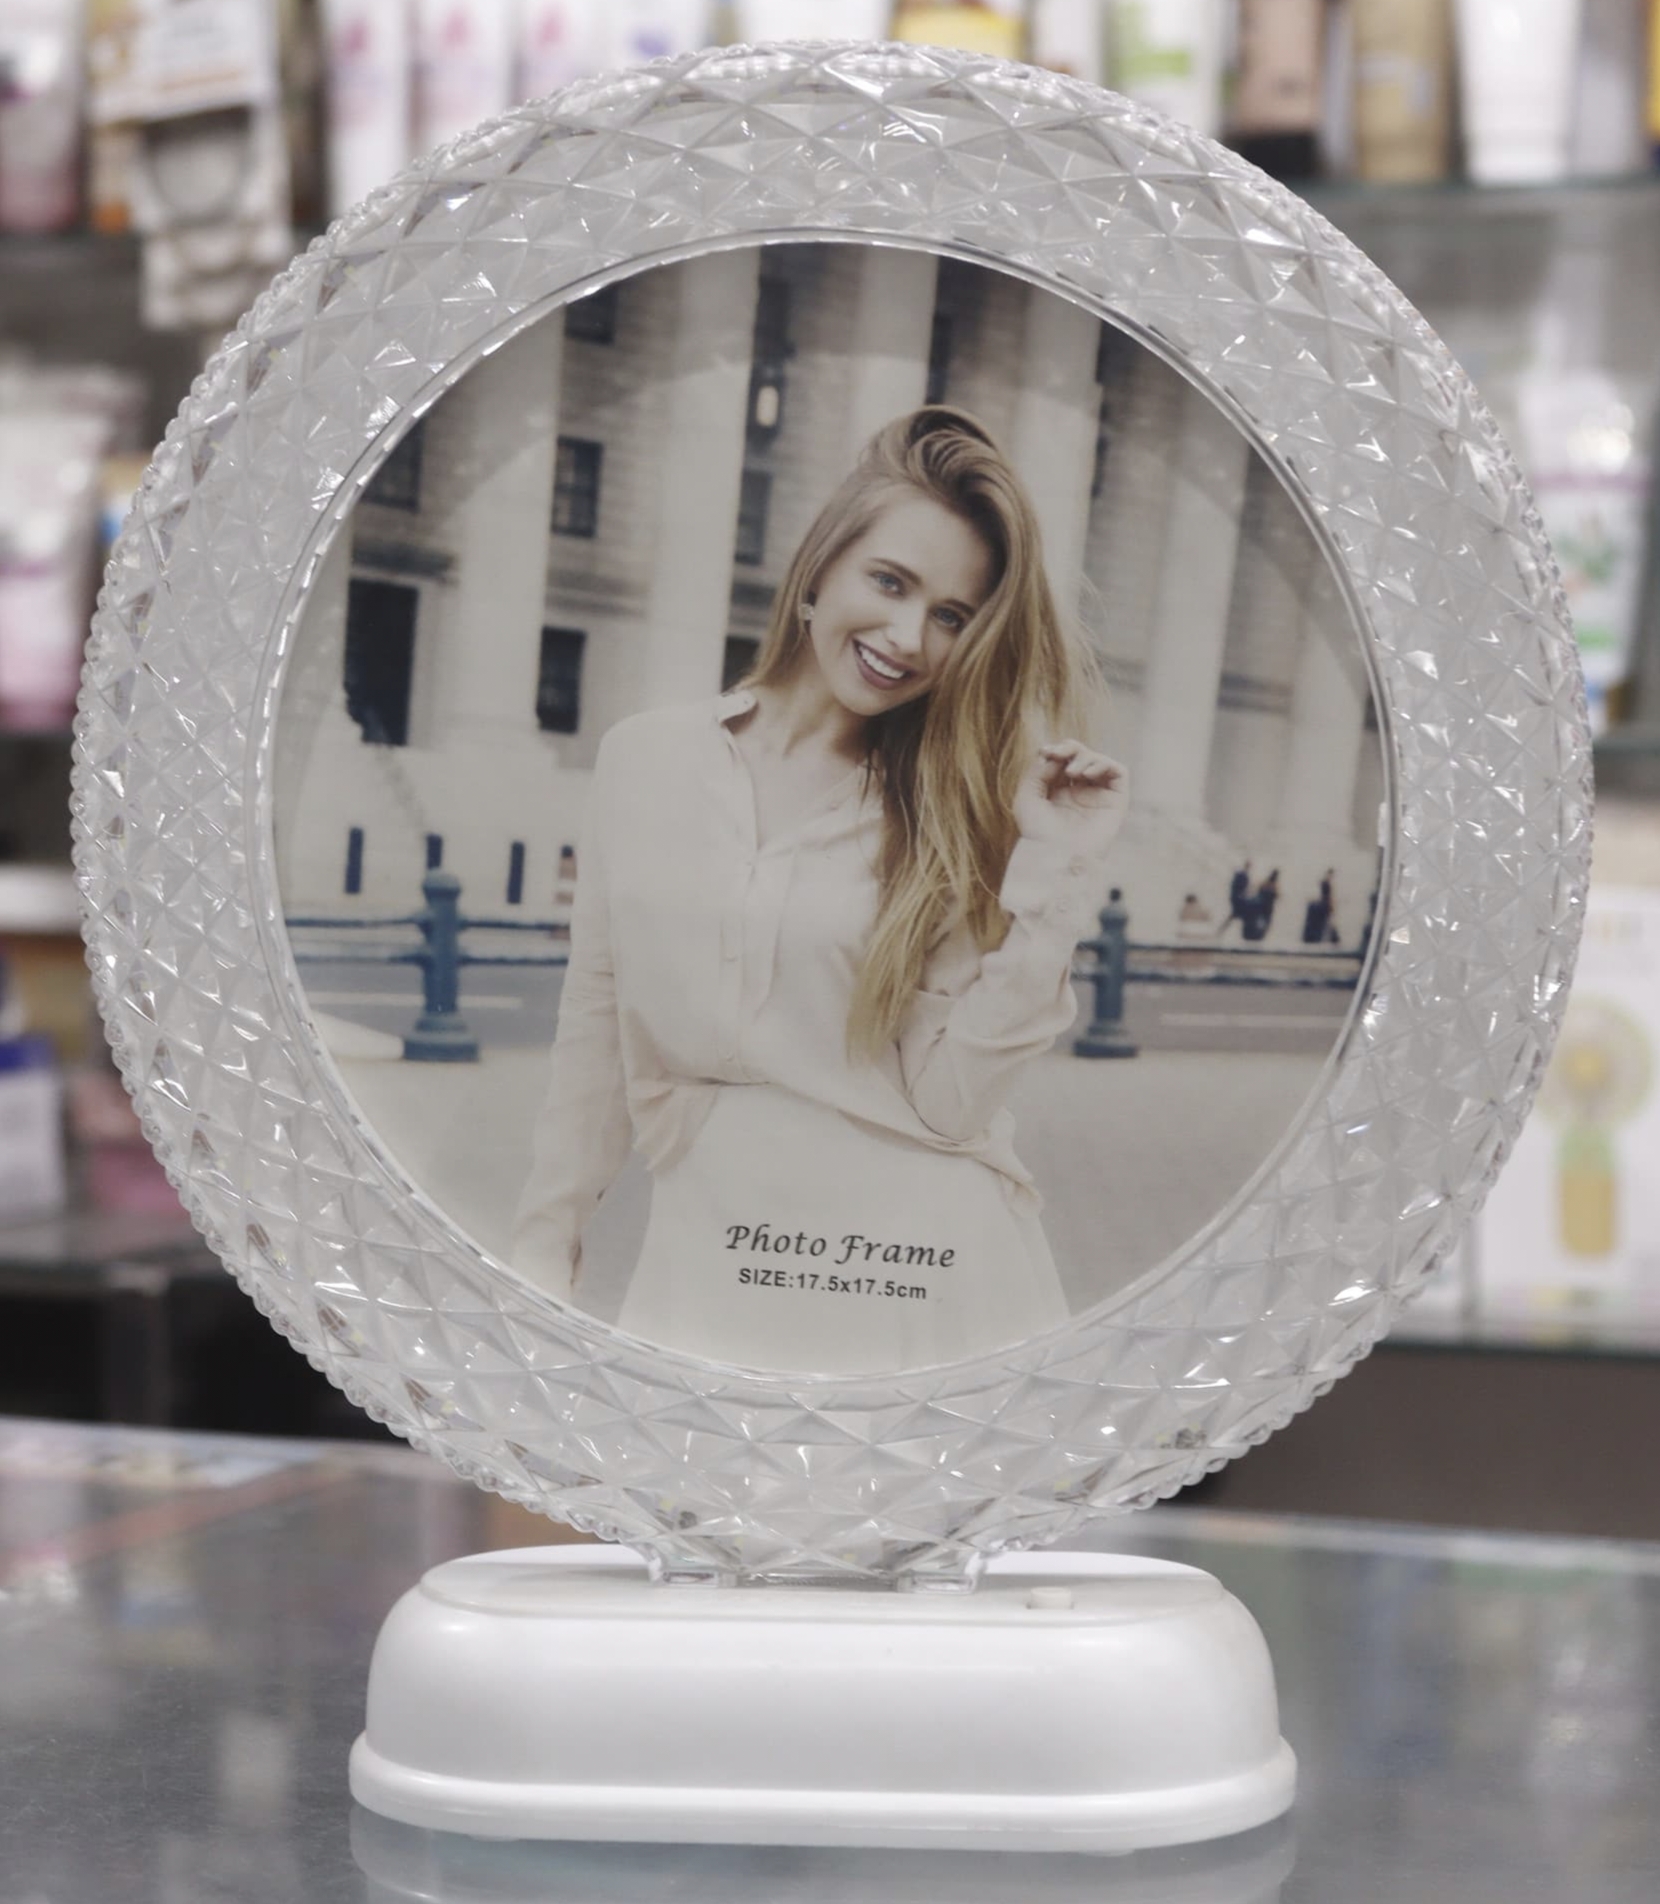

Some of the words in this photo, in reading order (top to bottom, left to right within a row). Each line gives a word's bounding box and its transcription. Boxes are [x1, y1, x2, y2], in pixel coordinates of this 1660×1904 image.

[726, 1223, 827, 1256] Photo
[834, 1235, 955, 1267] Frame
[738, 1268, 927, 1299] SIZE:17.5x17.5cm
